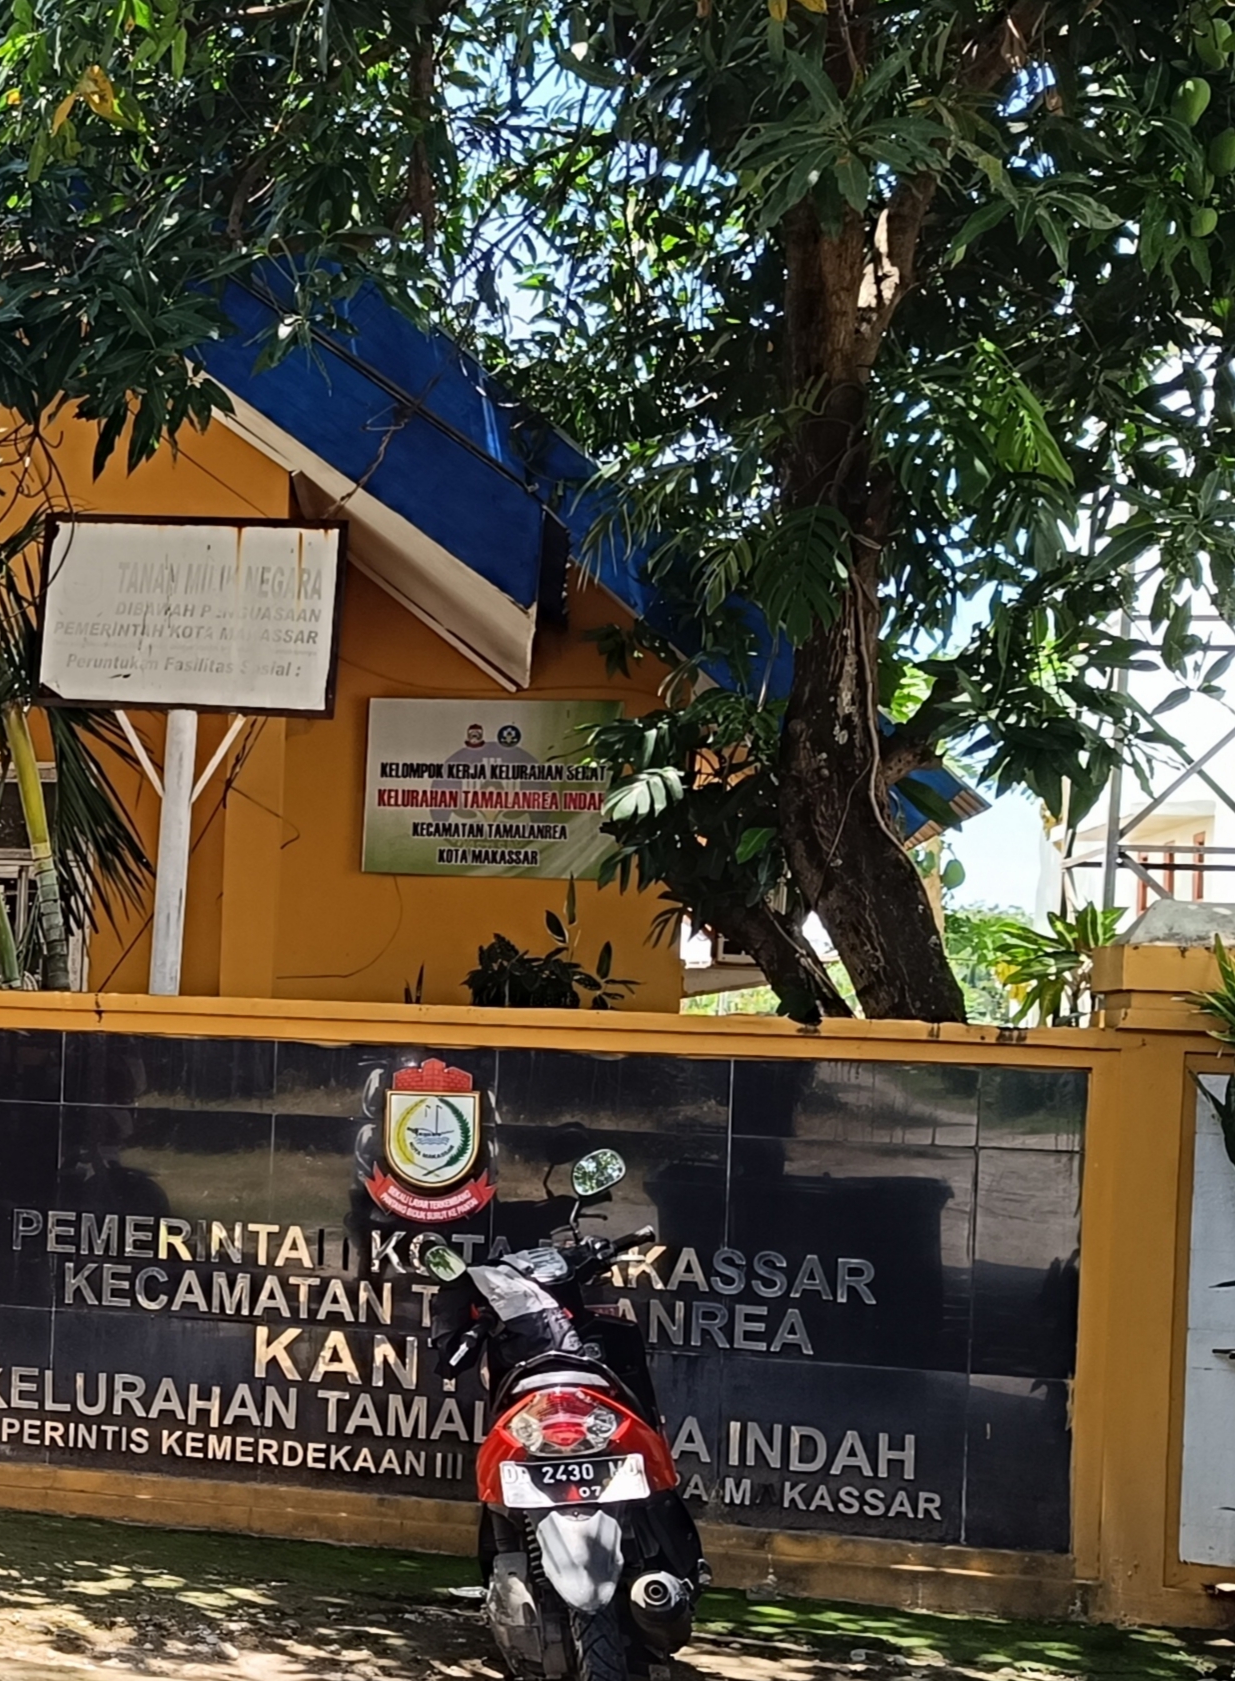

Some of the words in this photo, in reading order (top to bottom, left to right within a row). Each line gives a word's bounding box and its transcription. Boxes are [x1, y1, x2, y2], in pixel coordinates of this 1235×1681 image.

[245, 565, 322, 600] NEGARA
[200, 604, 321, 623] PNGUASAAN
[53, 621, 164, 639] PEMERINTAH
[169, 623, 214, 640] KOTA
[164, 656, 234, 675] Fasilitas
[380, 762, 444, 780] KELOMPOK
[447, 763, 487, 781] KERJA
[490, 764, 564, 782] KELURAHAN
[377, 788, 459, 808] KELURAHAN
[462, 790, 559, 810] TAMALANREA
[411, 821, 484, 838] KECAMATAN
[487, 823, 568, 840] TAMALANREA
[437, 848, 468, 864] KOTA
[471, 849, 539, 866] MAKASSAR
[12, 1208, 350, 1271] PEMERINTA
[539, 1239, 877, 1304] KASSAR
[64, 1262, 392, 1325] KECAMATAN
[1, 1417, 150, 1455] PERINTIS
[161, 1429, 426, 1477] KEMERDEKAAN
[728, 1420, 916, 1480] INDAH
[541, 1463, 595, 1484] 2430
[578, 1486, 602, 1498] 07
